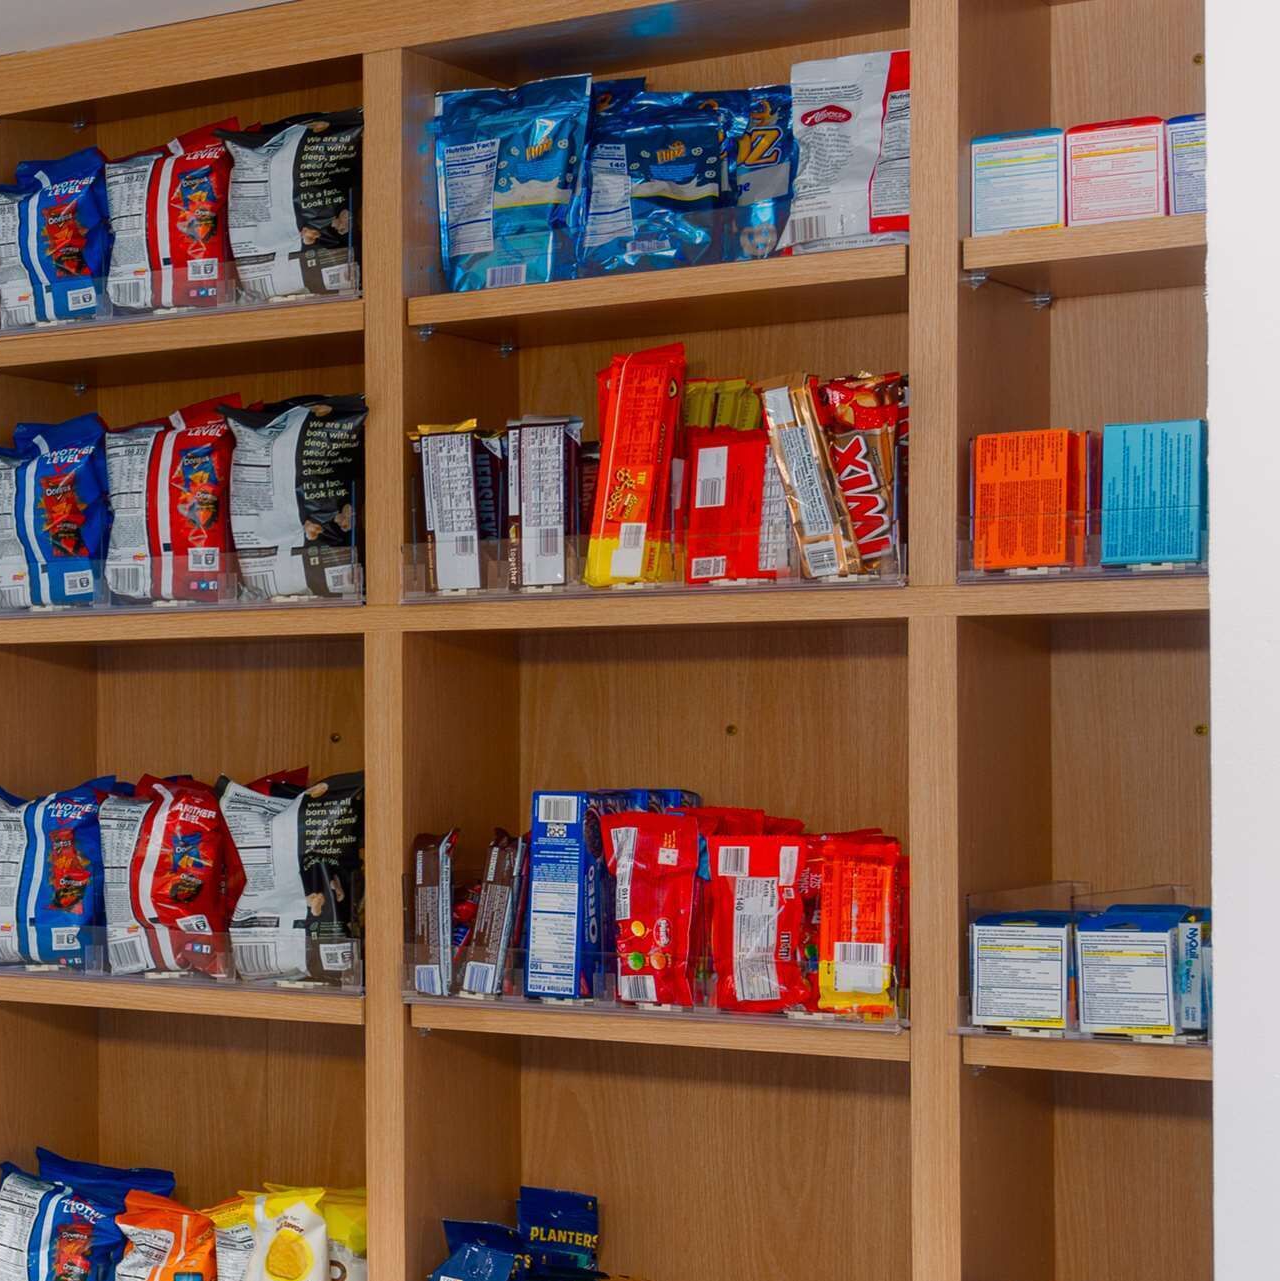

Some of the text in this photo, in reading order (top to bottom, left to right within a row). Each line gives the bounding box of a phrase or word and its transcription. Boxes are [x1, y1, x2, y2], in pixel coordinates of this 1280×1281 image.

[327, 143, 347, 152] with
[300, 160, 323, 169] need
[608, 162, 626, 171] 140
[48, 184, 82, 197] LEVEL
[302, 200, 320, 210] Look
[329, 430, 350, 439] with
[303, 448, 326, 457] need
[46, 454, 81, 465] LEVEL
[304, 491, 324, 501] Look
[833, 433, 897, 562] TWIX
[339, 797, 352, 806] all
[47, 801, 100, 814] ANOTHER
[305, 807, 327, 816] born
[50, 809, 83, 820] LEVEL
[305, 817, 333, 829] deep,
[305, 826, 343, 836] need for
[305, 834, 359, 848] savory white
[587, 864, 598, 944] OREO
[735, 896, 743, 912] 140
[1188, 927, 1199, 960] NyQuil
[529, 1225, 599, 1250] PLANTERS
